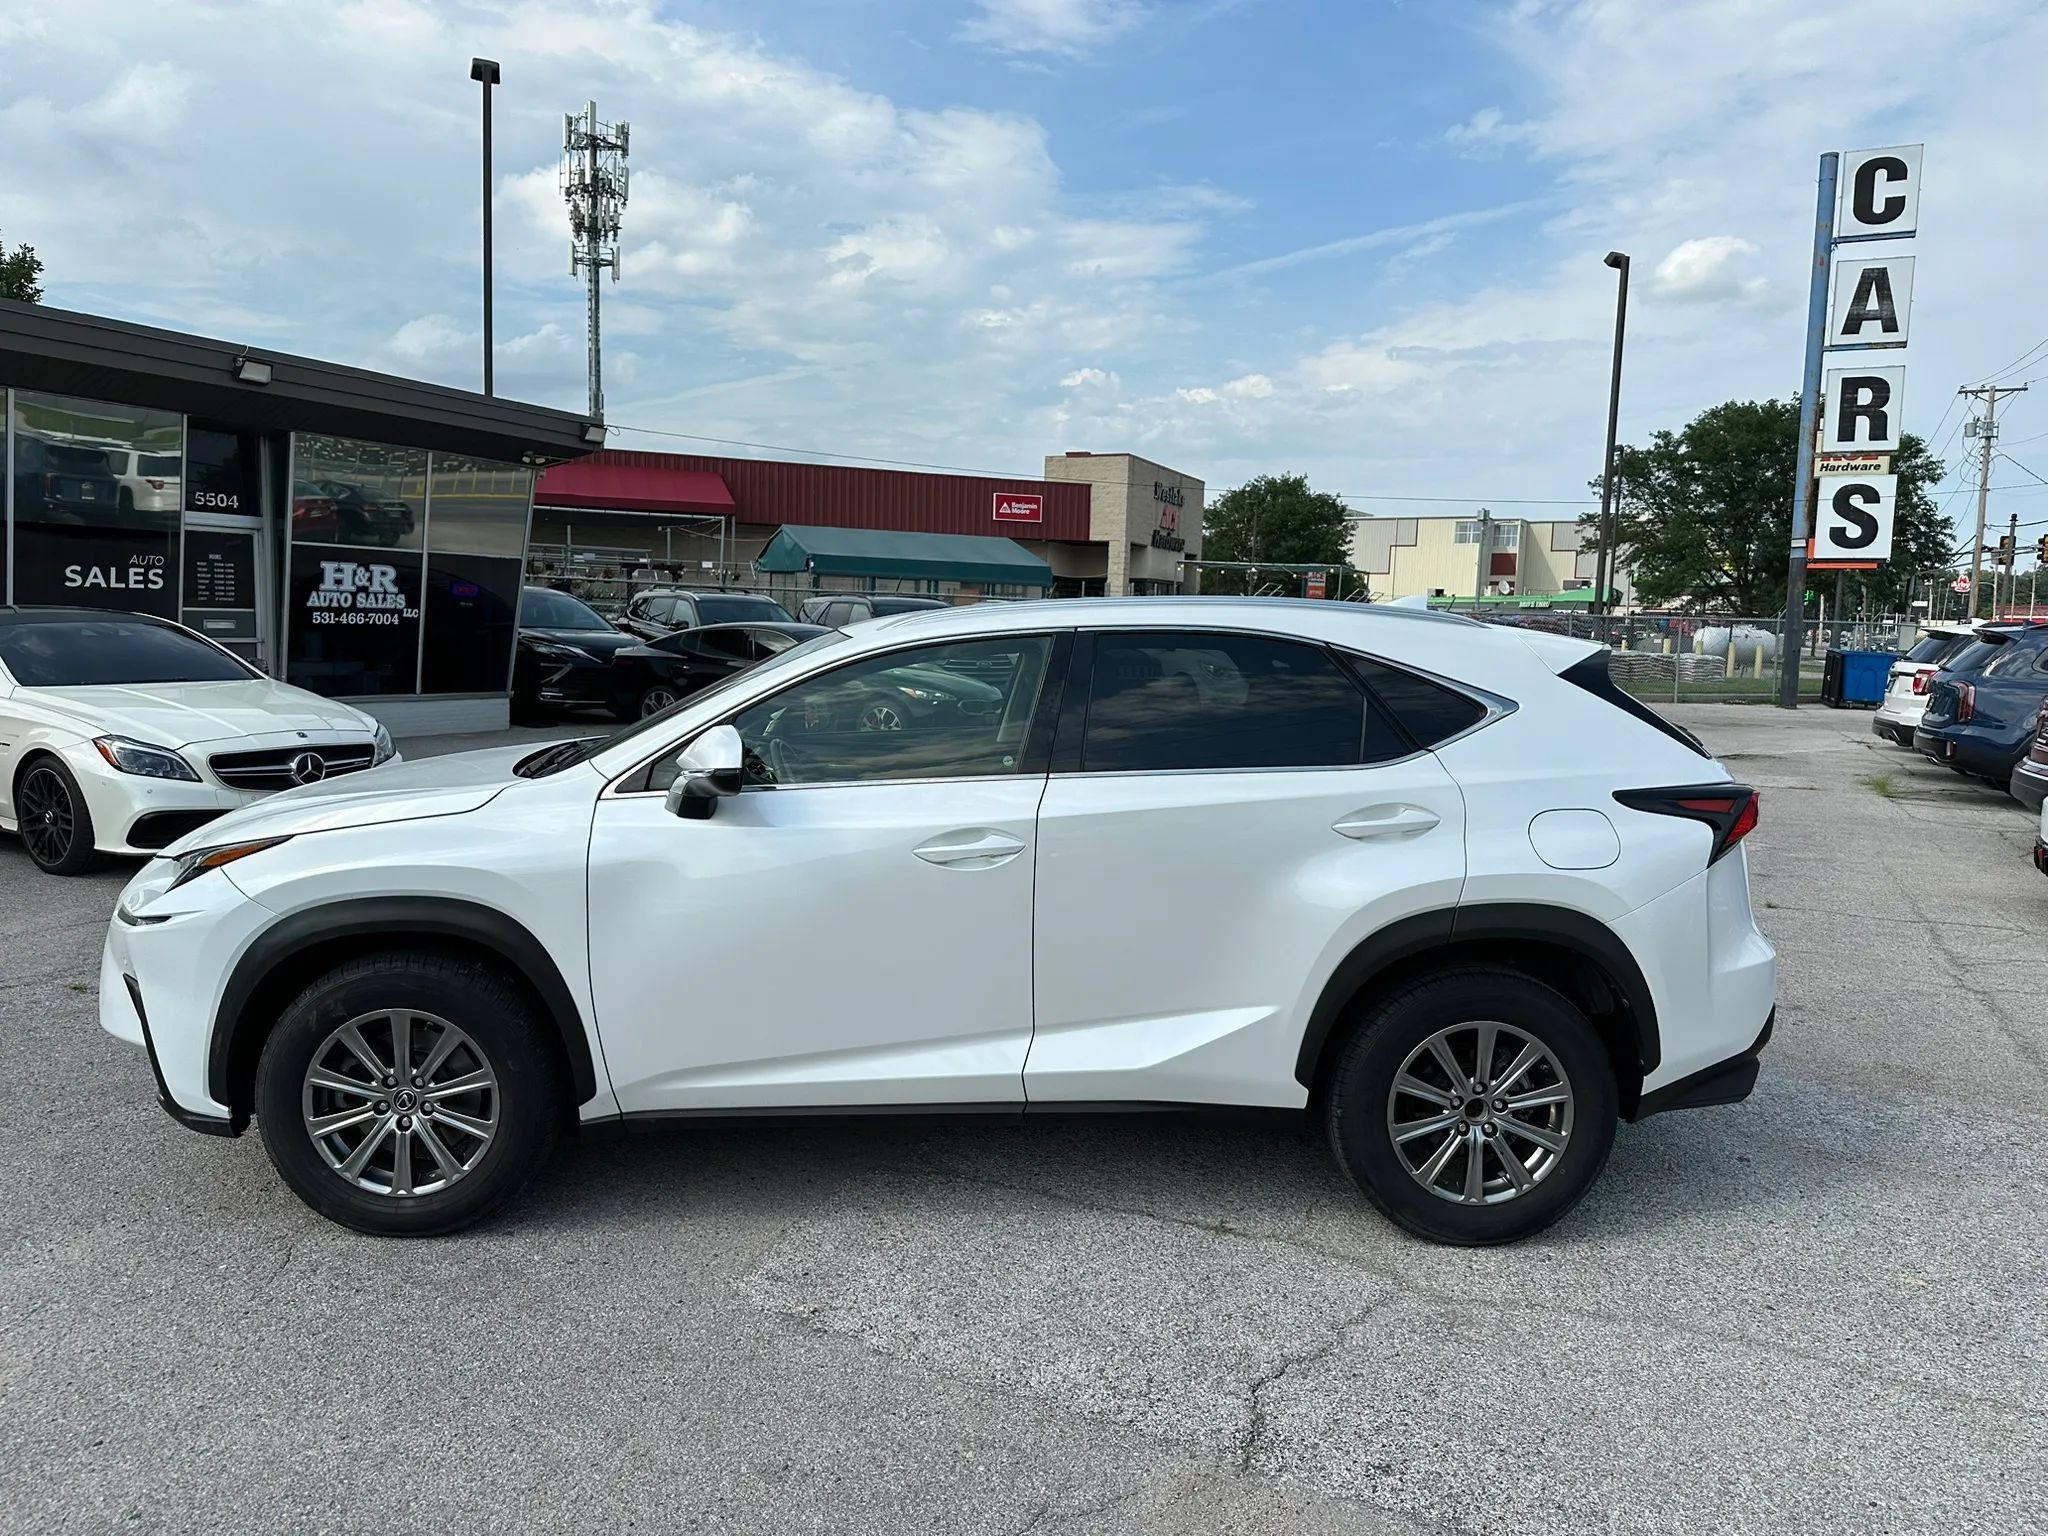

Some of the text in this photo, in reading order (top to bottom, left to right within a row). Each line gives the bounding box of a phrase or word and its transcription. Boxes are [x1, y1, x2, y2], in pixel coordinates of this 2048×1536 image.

[1819, 463, 1882, 472] Hardware
[194, 491, 239, 509] 5504
[1011, 502, 1038, 510] Benjamin
[129, 554, 165, 566] AUTO
[64, 565, 164, 590] SALES
[319, 561, 399, 594] H&R
[306, 590, 406, 609] AUTO SALES
[312, 612, 400, 625] 531-466-7004
[402, 608, 419, 618] LLC
